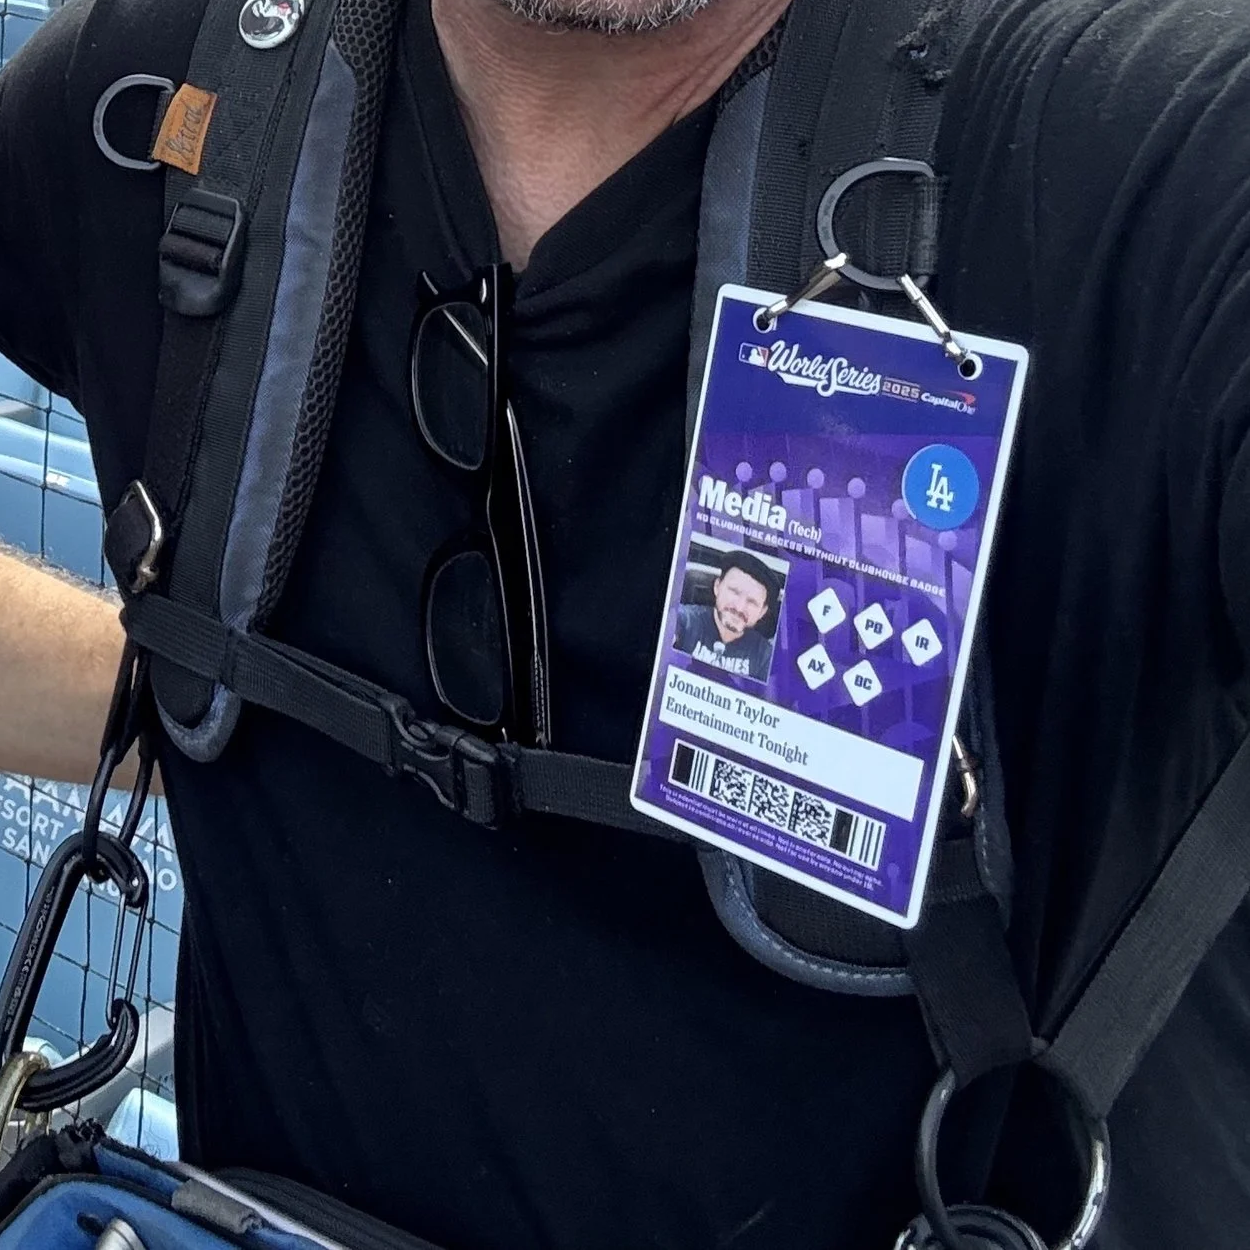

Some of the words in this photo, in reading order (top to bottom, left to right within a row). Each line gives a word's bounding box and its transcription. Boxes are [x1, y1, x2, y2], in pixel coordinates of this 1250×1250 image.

[882, 380, 921, 399] 2025
[925, 463, 954, 511] LA
[698, 475, 788, 532] Media
[788, 520, 823, 544] (Tech)
[696, 512, 709, 522] NO
[709, 516, 764, 541] CLUBHOUSE
[764, 533, 802, 553] ACCESS
[803, 545, 849, 566] WITHOUT
[848, 559, 909, 586] CLUBHOUSE
[910, 579, 947, 598] BADGE
[822, 605, 830, 617] F
[915, 635, 930, 651] IR
[807, 659, 826, 675] AX
[669, 674, 732, 711] Jonathan
[736, 698, 781, 729] Taylor
[665, 695, 755, 748] Entertainment
[758, 732, 810, 766] Tonight
[2, 828, 51, 865] SAN
